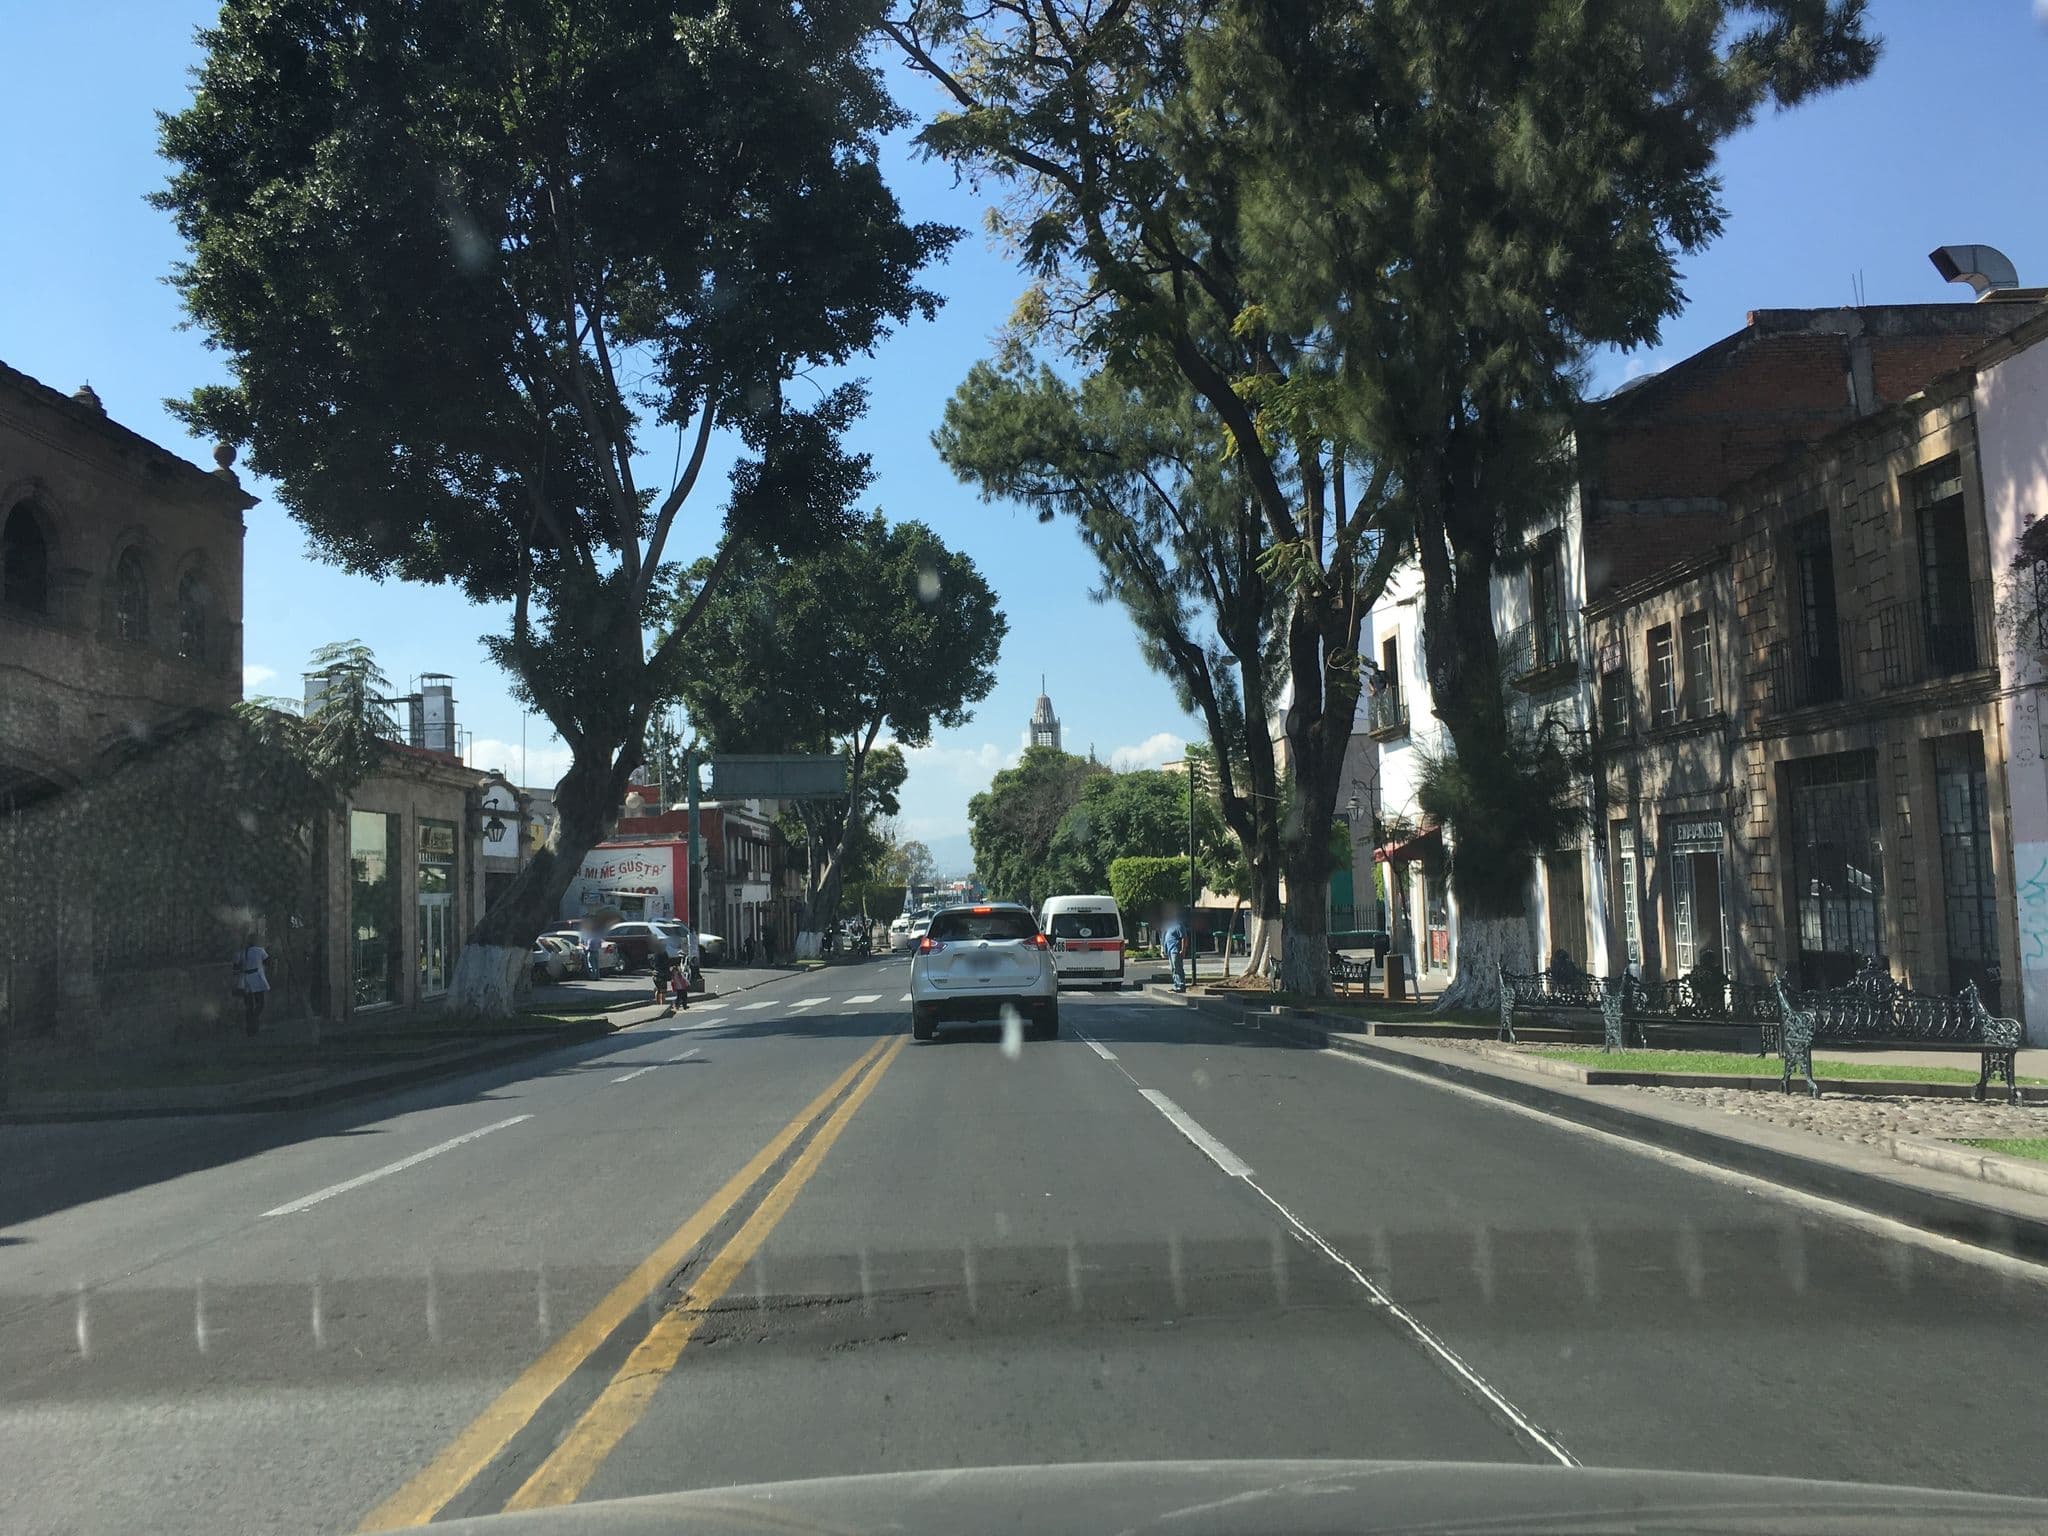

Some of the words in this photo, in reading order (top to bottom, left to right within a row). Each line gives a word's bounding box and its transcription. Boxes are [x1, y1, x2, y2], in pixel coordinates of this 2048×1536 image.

[585, 868, 598, 879] MI
[600, 866, 616, 879] ME
[619, 861, 660, 877] GUSTA
